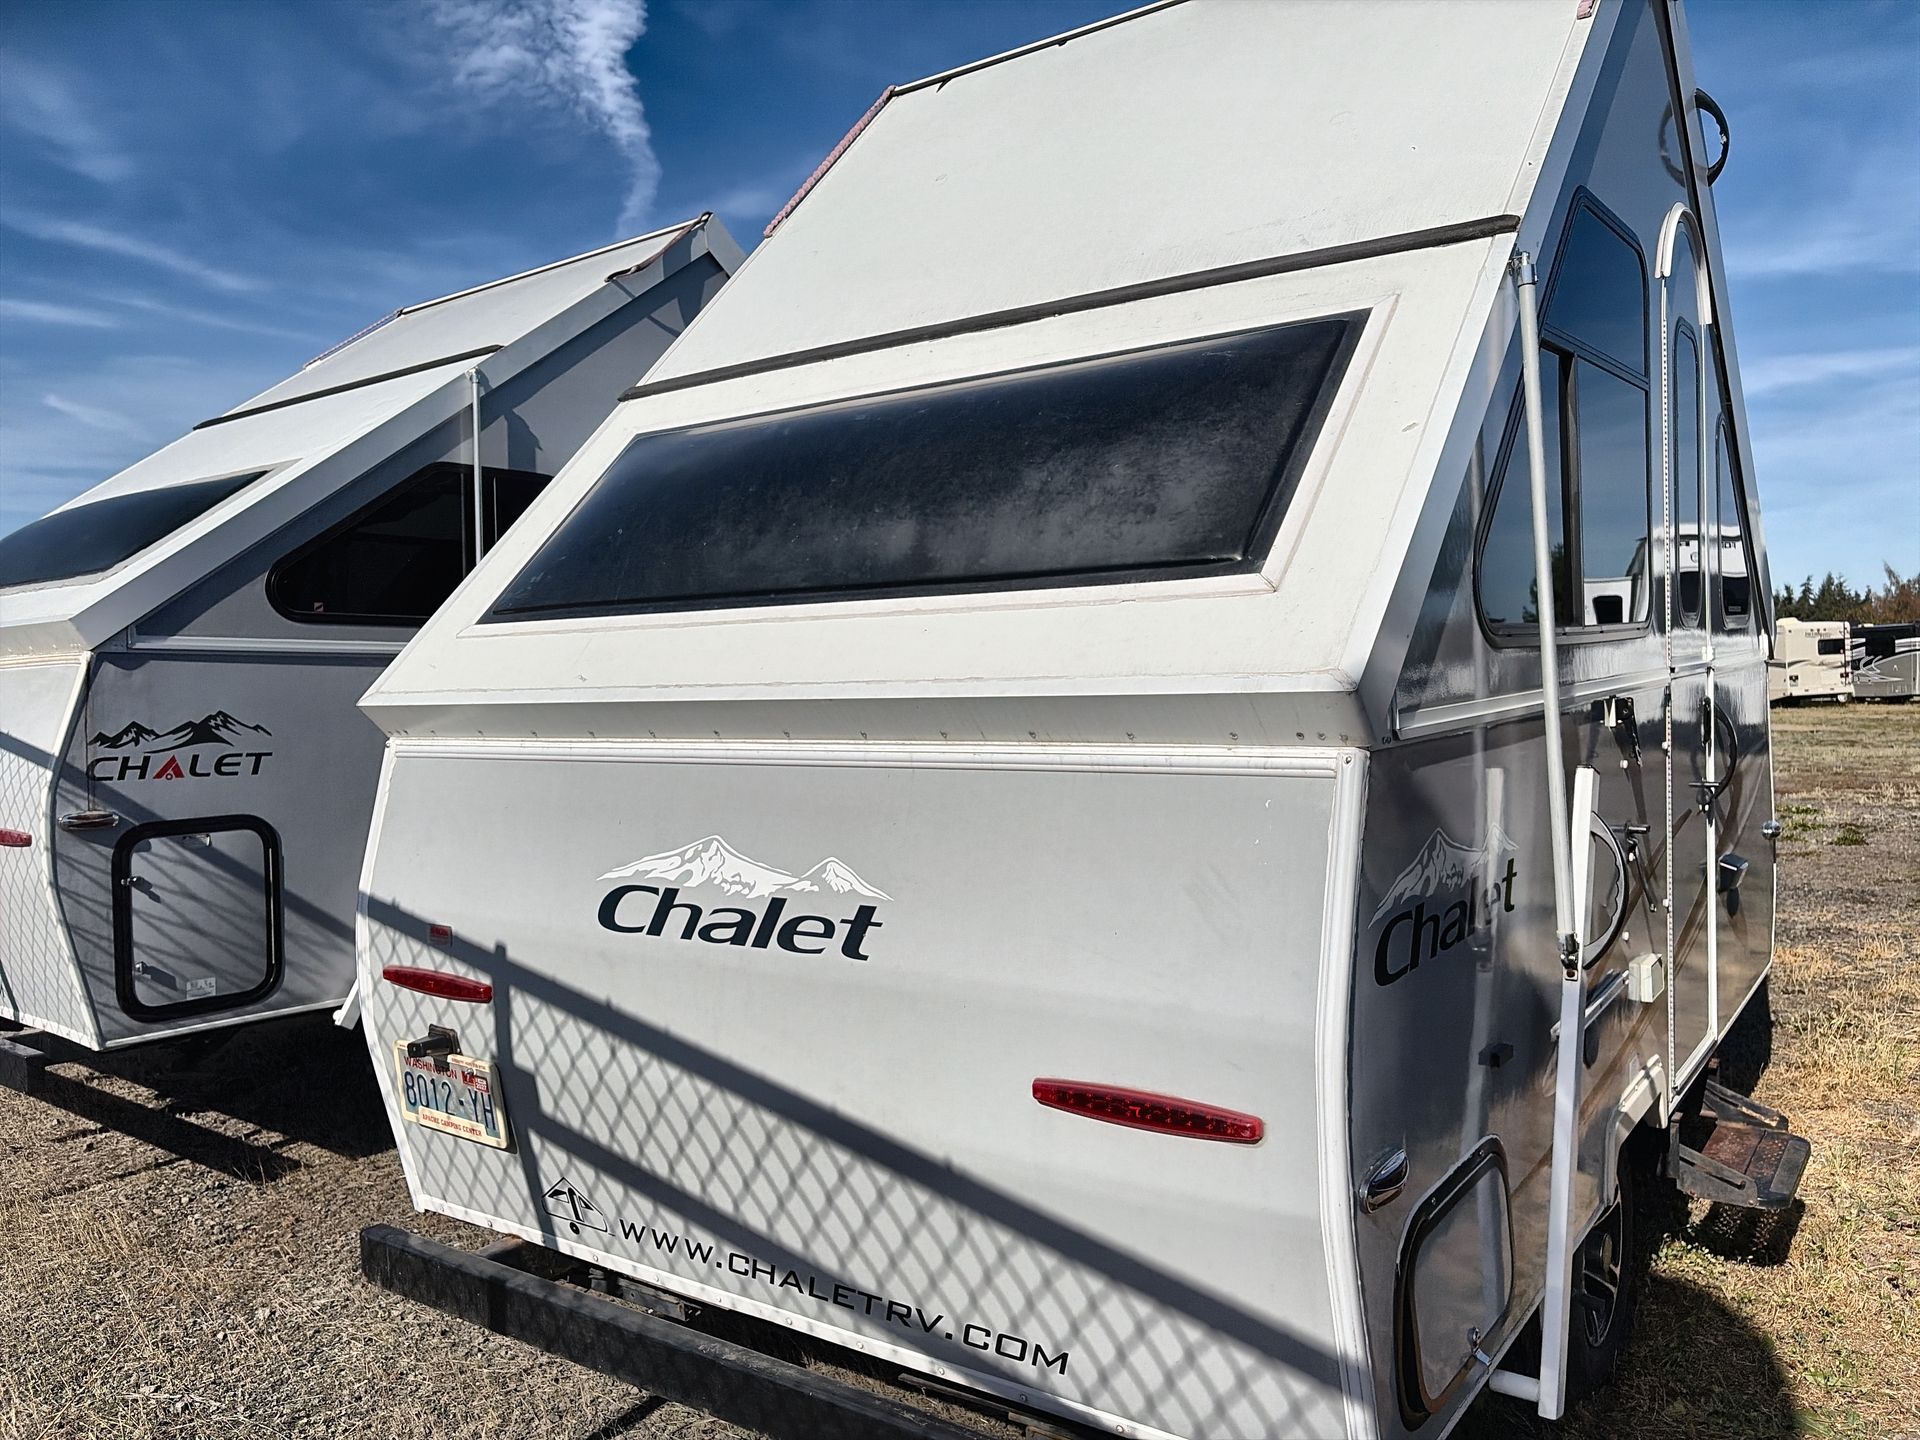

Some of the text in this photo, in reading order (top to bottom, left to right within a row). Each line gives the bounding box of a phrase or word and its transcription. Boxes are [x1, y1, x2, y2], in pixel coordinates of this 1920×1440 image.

[86, 751, 273, 782] CHALET
[597, 884, 884, 961] Chalet
[1374, 857, 1518, 986] Chalet
[440, 1118, 462, 1131] CAMPING
[462, 1125, 483, 1137] CENTER
[619, 1218, 1070, 1376] WWW.CHALETRV.COM
